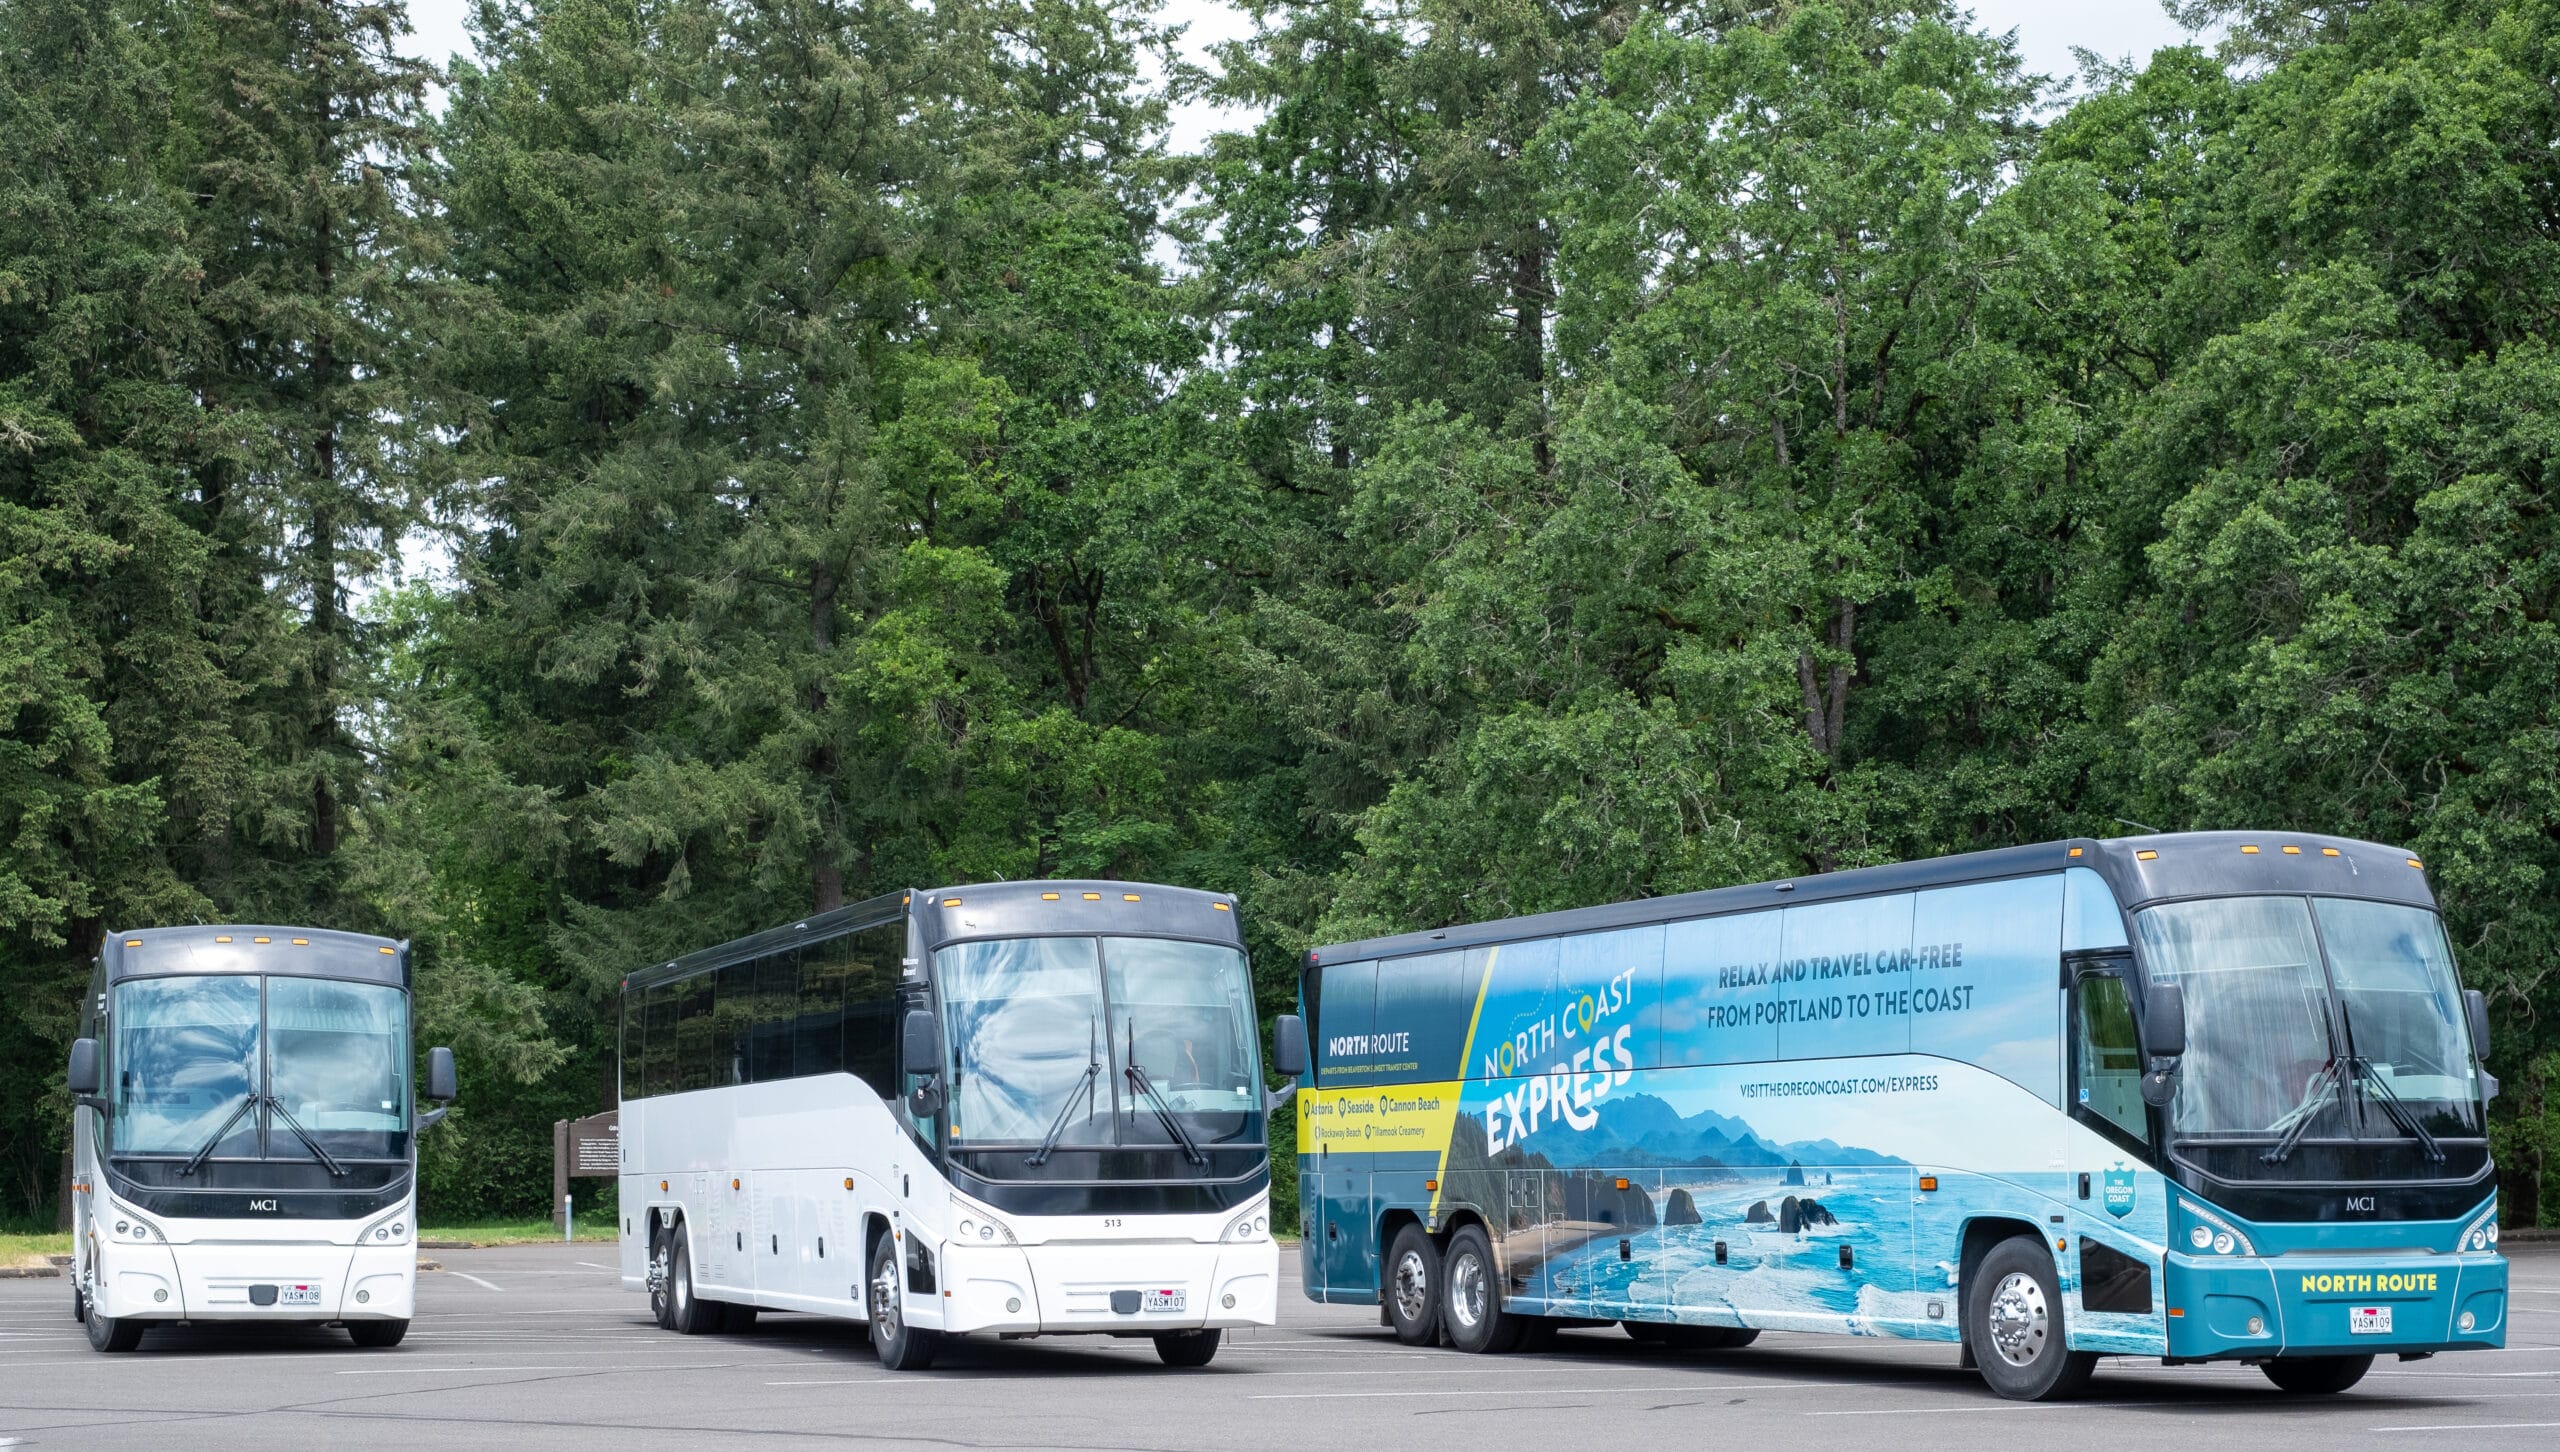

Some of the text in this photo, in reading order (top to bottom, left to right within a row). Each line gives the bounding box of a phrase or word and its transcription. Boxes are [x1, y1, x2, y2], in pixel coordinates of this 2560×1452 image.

[1719, 943, 1962, 988] RELAX AND TRAVEL CAR-FREE
[1708, 985, 1974, 1028] FROM PORTLAND TO THE COAST
[1485, 966, 1636, 1087] NORTH COAST
[1329, 1032, 1410, 1056] NORTH ROUTE
[1486, 1024, 1633, 1158] EXPRESS
[1740, 1075, 1939, 1098] VISITTHEOREGONCOAST.COM/EXPRESS
[1311, 1096, 1440, 1115] Astoria Seaside Cannon Beach
[1321, 1125, 1425, 1140] Rockaway Beach Tillamook Creamery
[2105, 1186, 2133, 1194] OREGON
[249, 1199, 277, 1211] MCI
[2108, 1195, 2130, 1203] COAST
[2346, 1197, 2375, 1211] MCI
[1104, 1219, 1122, 1228] 513
[2302, 1273, 2437, 1292] NORTH ROUTE
[284, 1291, 319, 1300] YASW108
[1148, 1297, 1184, 1307] YASW107
[2352, 1317, 2390, 1329] YASW109
